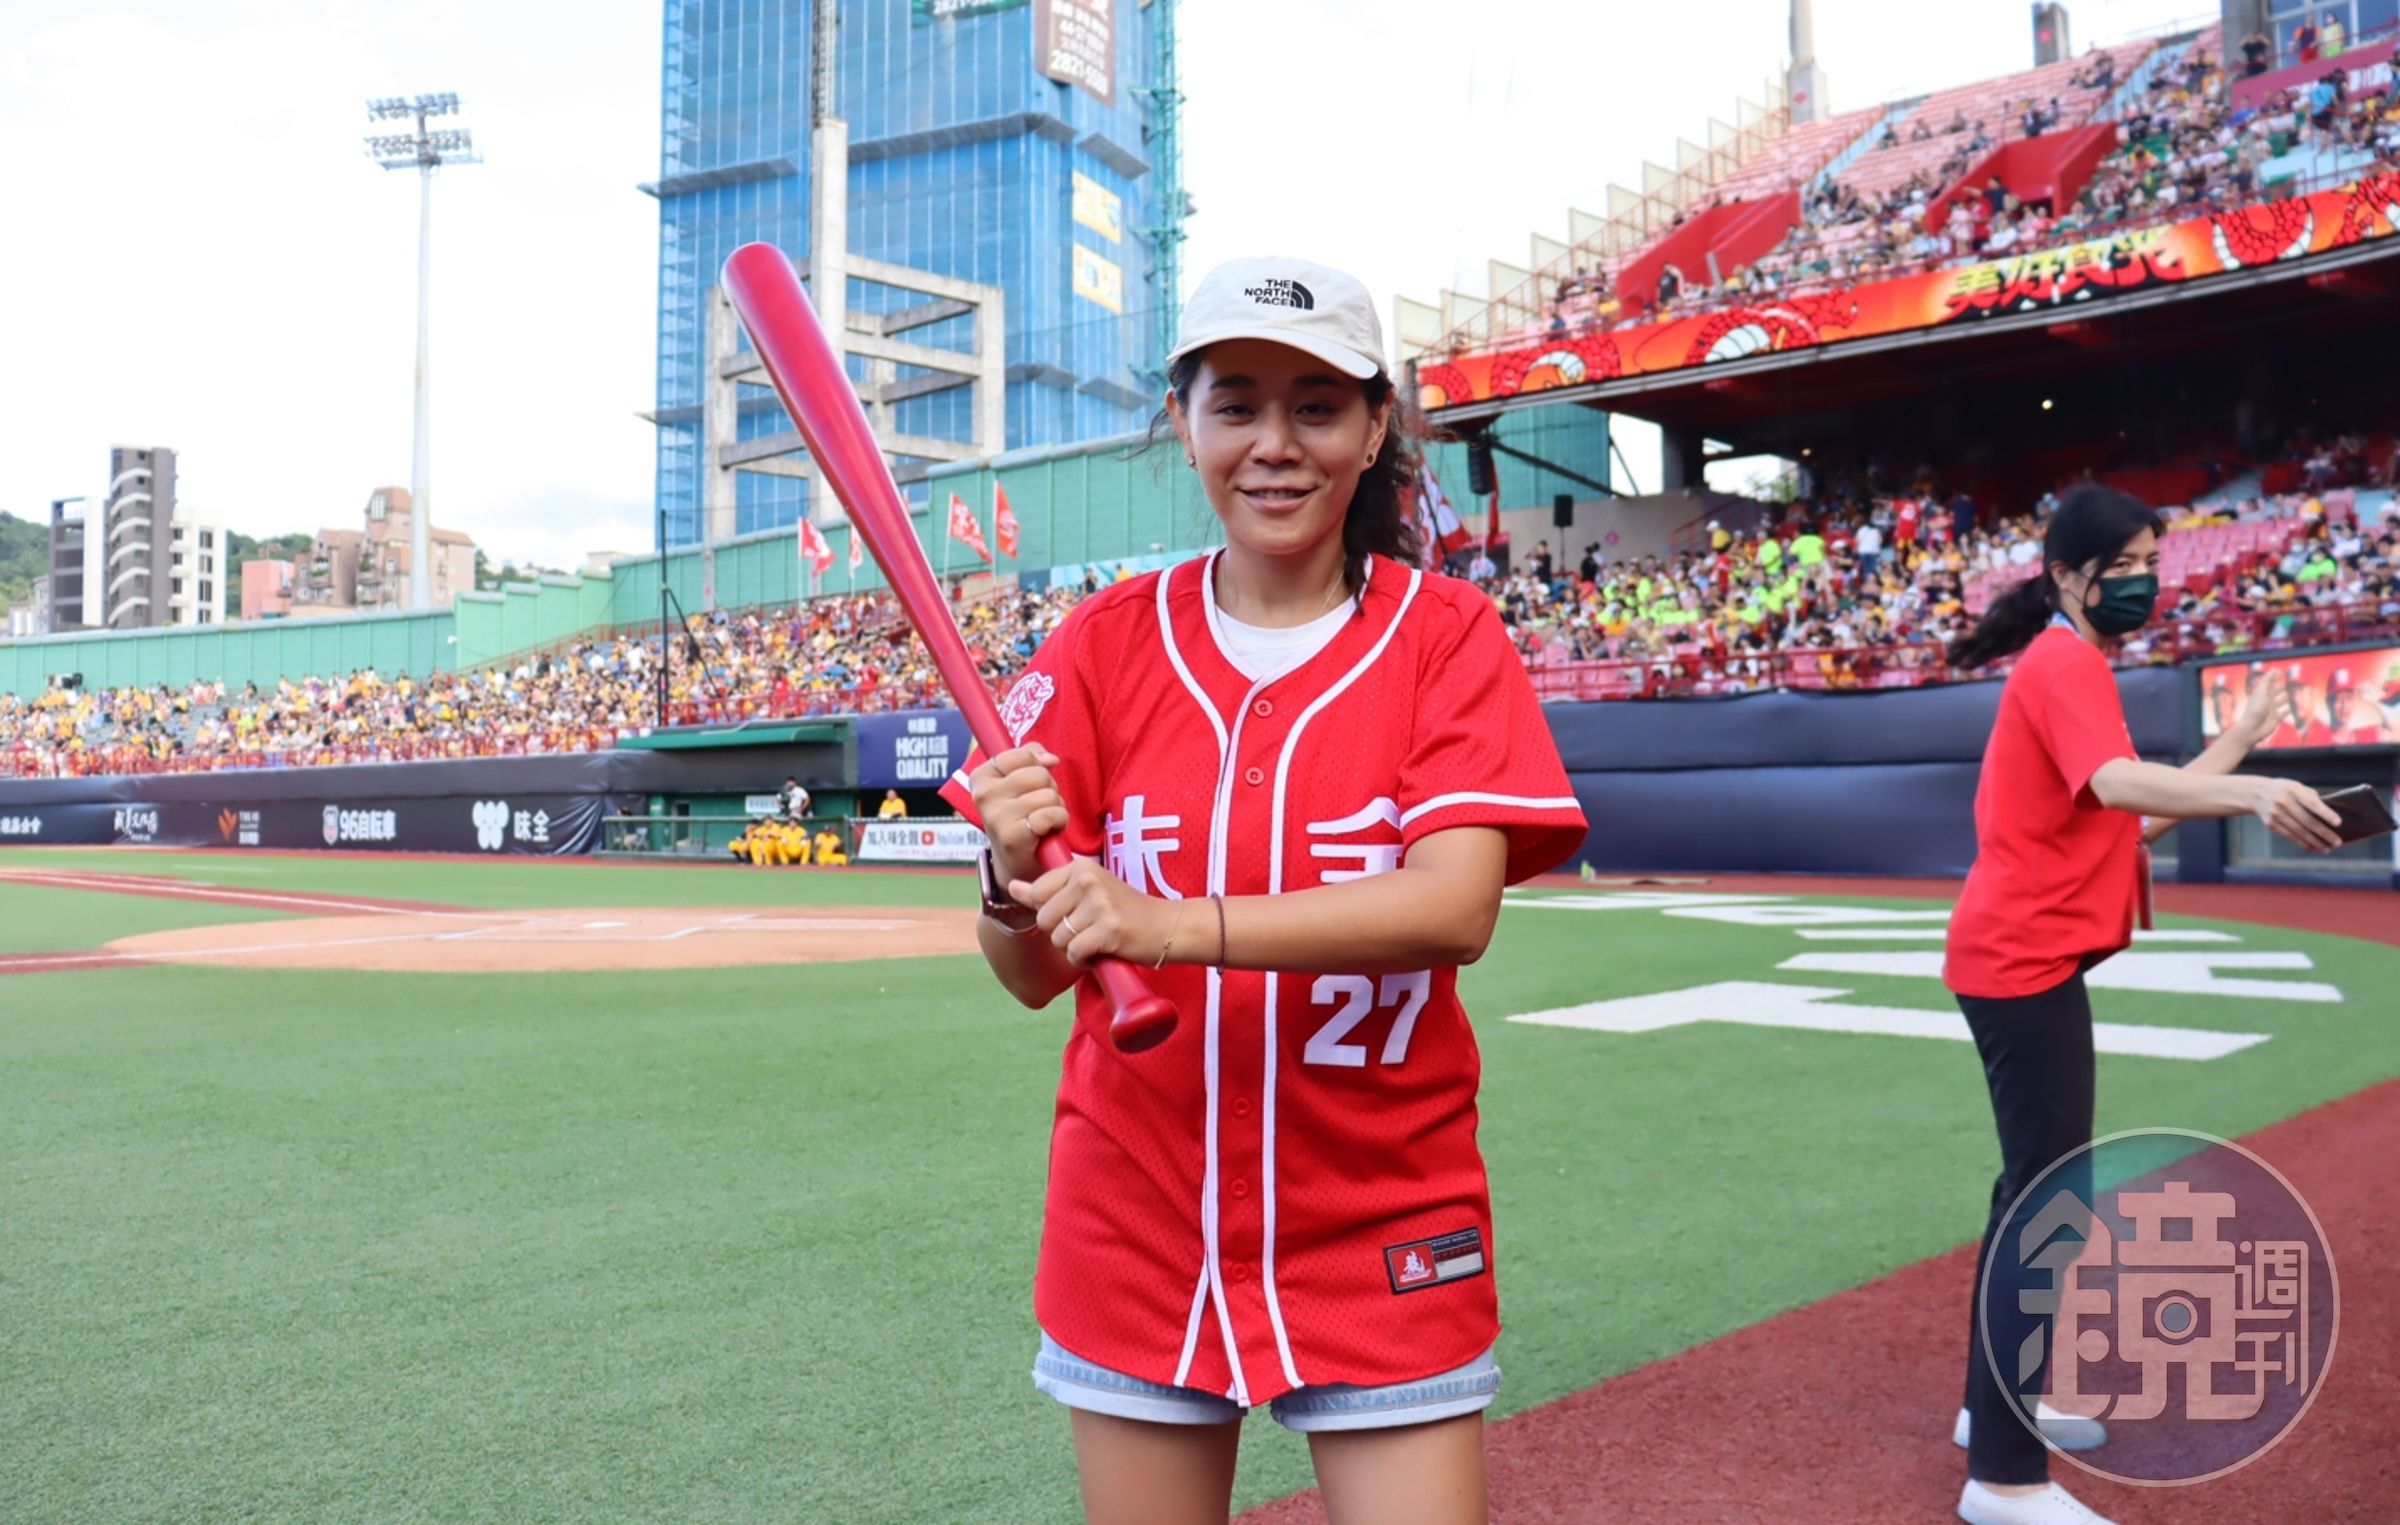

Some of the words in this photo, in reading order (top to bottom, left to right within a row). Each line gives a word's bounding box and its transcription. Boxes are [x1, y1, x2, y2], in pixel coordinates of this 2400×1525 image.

[1244, 288, 1291, 298] NORTH
[1265, 279, 1291, 288] THE
[1255, 296, 1289, 306] FACE
[896, 737, 927, 758] HIGH
[896, 758, 949, 780] QUALITY
[513, 809, 550, 842] 味全
[1501, 886, 2344, 1062] TAIPE
[1303, 970, 1431, 1067] 27
